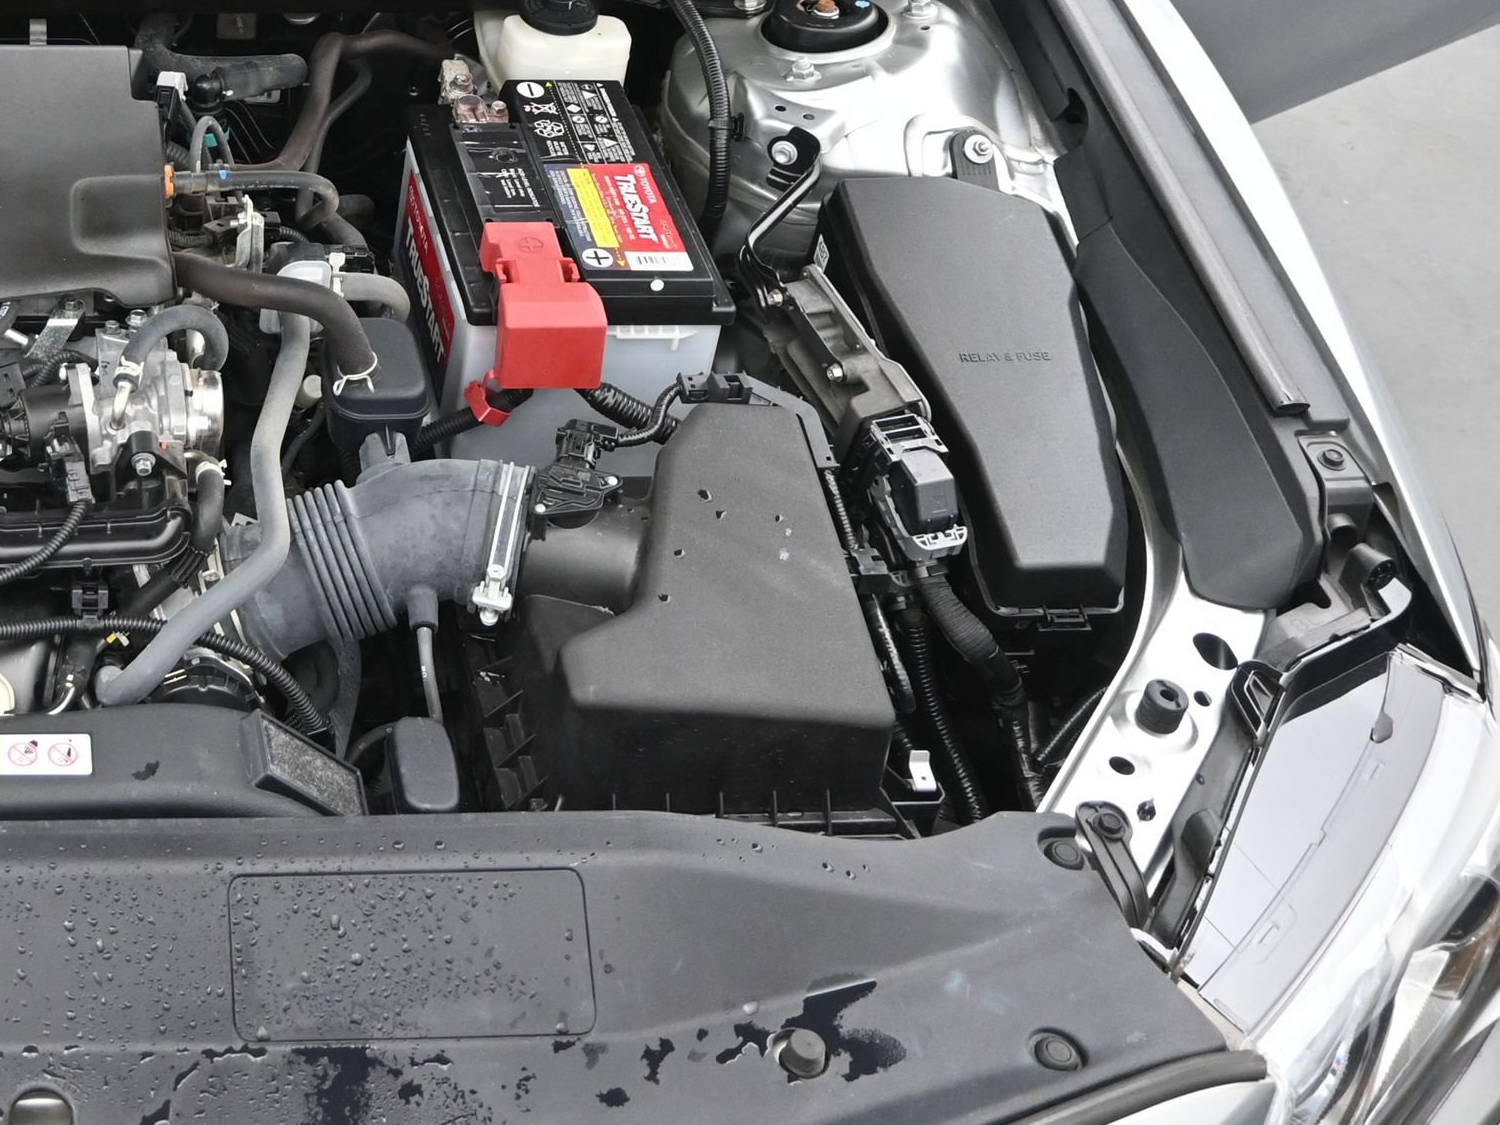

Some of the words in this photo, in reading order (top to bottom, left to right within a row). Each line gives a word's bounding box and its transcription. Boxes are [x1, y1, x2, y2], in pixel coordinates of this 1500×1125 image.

[640, 177, 657, 204] TOYOTA
[959, 353, 1000, 363] RELAY
[1016, 352, 1052, 362] FUSE
